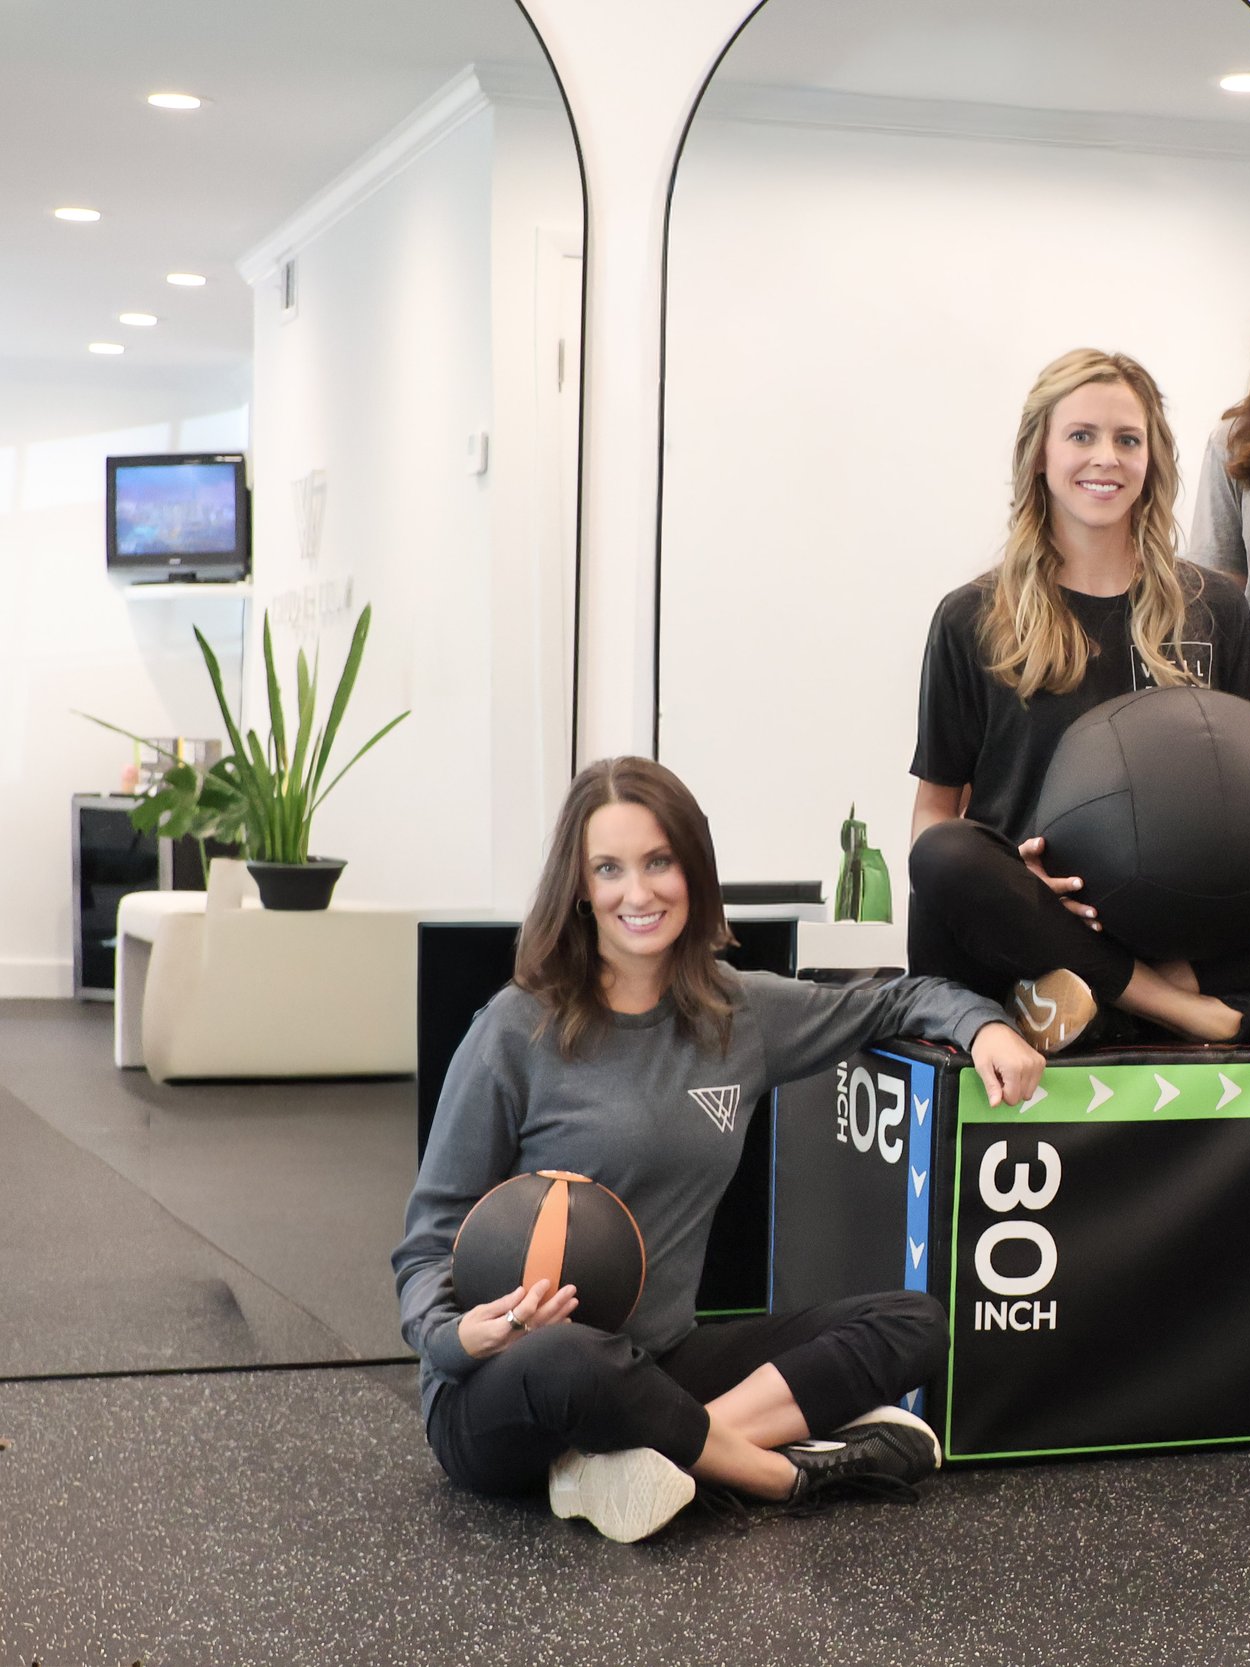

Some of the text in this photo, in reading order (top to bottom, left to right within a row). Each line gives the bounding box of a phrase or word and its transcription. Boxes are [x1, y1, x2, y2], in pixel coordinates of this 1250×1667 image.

[836, 1061, 848, 1143] INCH
[849, 1066, 906, 1164] 20
[974, 1140, 1062, 1296] 30
[974, 1300, 1057, 1331] INCH
